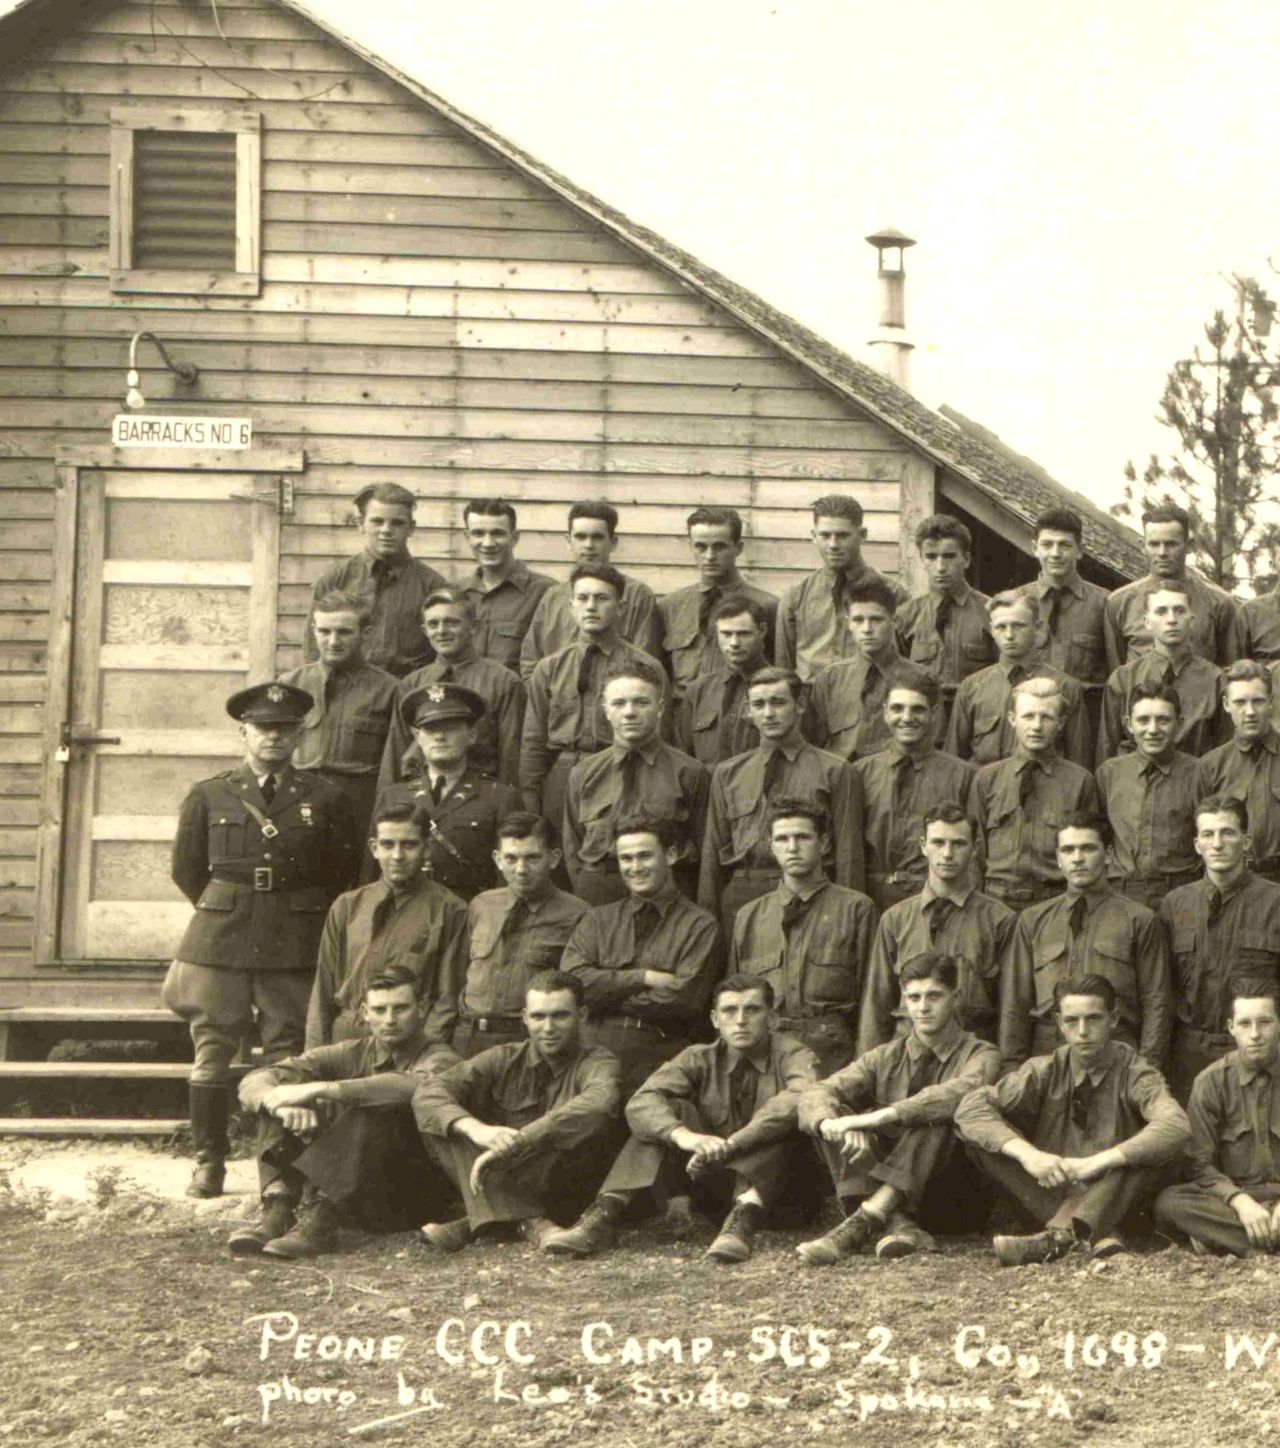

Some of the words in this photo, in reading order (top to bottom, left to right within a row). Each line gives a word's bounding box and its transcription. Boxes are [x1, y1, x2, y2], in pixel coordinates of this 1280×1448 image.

[119, 420, 204, 443] BARRACKS
[210, 423, 232, 443] NO
[240, 424, 249, 444] 6
